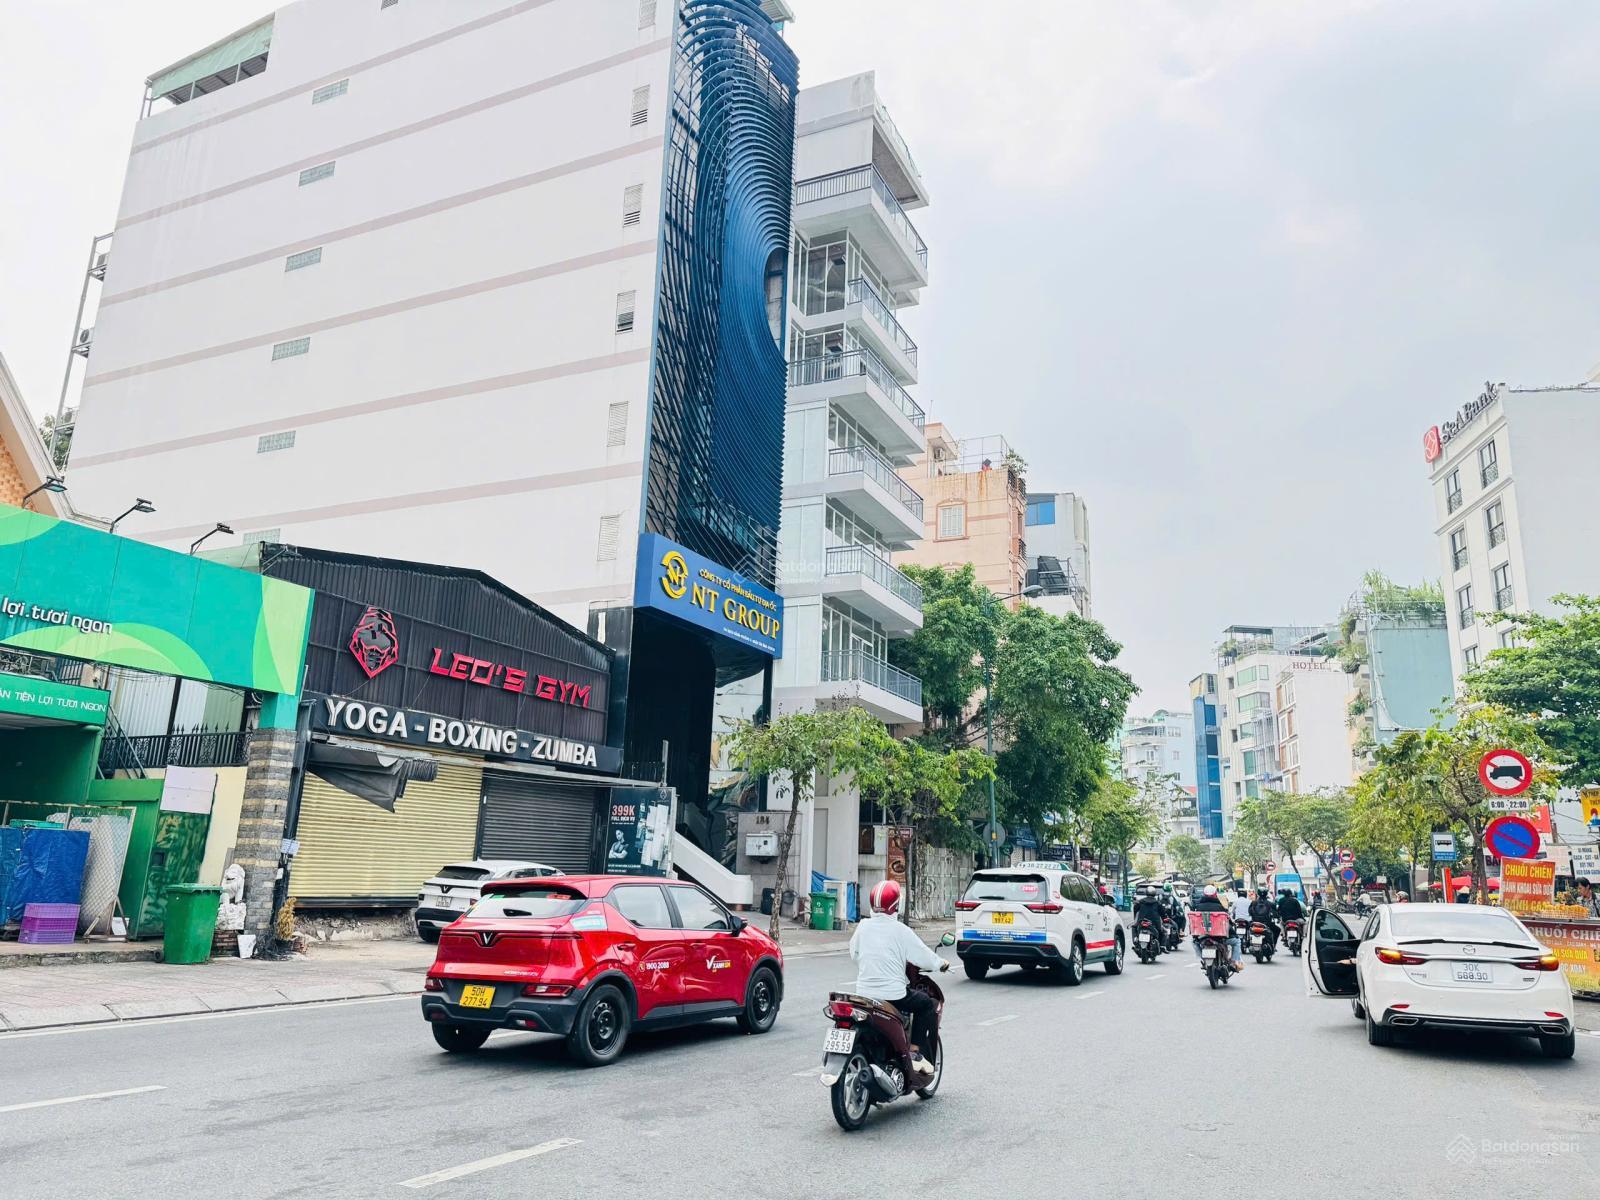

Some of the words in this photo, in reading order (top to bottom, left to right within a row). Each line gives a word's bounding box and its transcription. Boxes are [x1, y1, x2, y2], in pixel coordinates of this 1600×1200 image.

[690, 581, 719, 614] NT
[723, 598, 780, 640] GROUP
[31, 605, 69, 625] tươi
[71, 615, 113, 635] ngon
[1292, 661, 1325, 671] HOTEL
[430, 647, 527, 692] LEO'S
[535, 673, 593, 708] GYM
[38, 695, 53, 706] LỢI
[57, 698, 78, 708] TƯƠI
[80, 701, 106, 712] NGON
[324, 697, 408, 738] YOGA
[426, 717, 518, 754] BOXING
[530, 734, 597, 768] ZUMBA
[611, 805, 635, 816] 399K
[1510, 801, 1527, 809] 22:00
[1463, 964, 1480, 972] 30K
